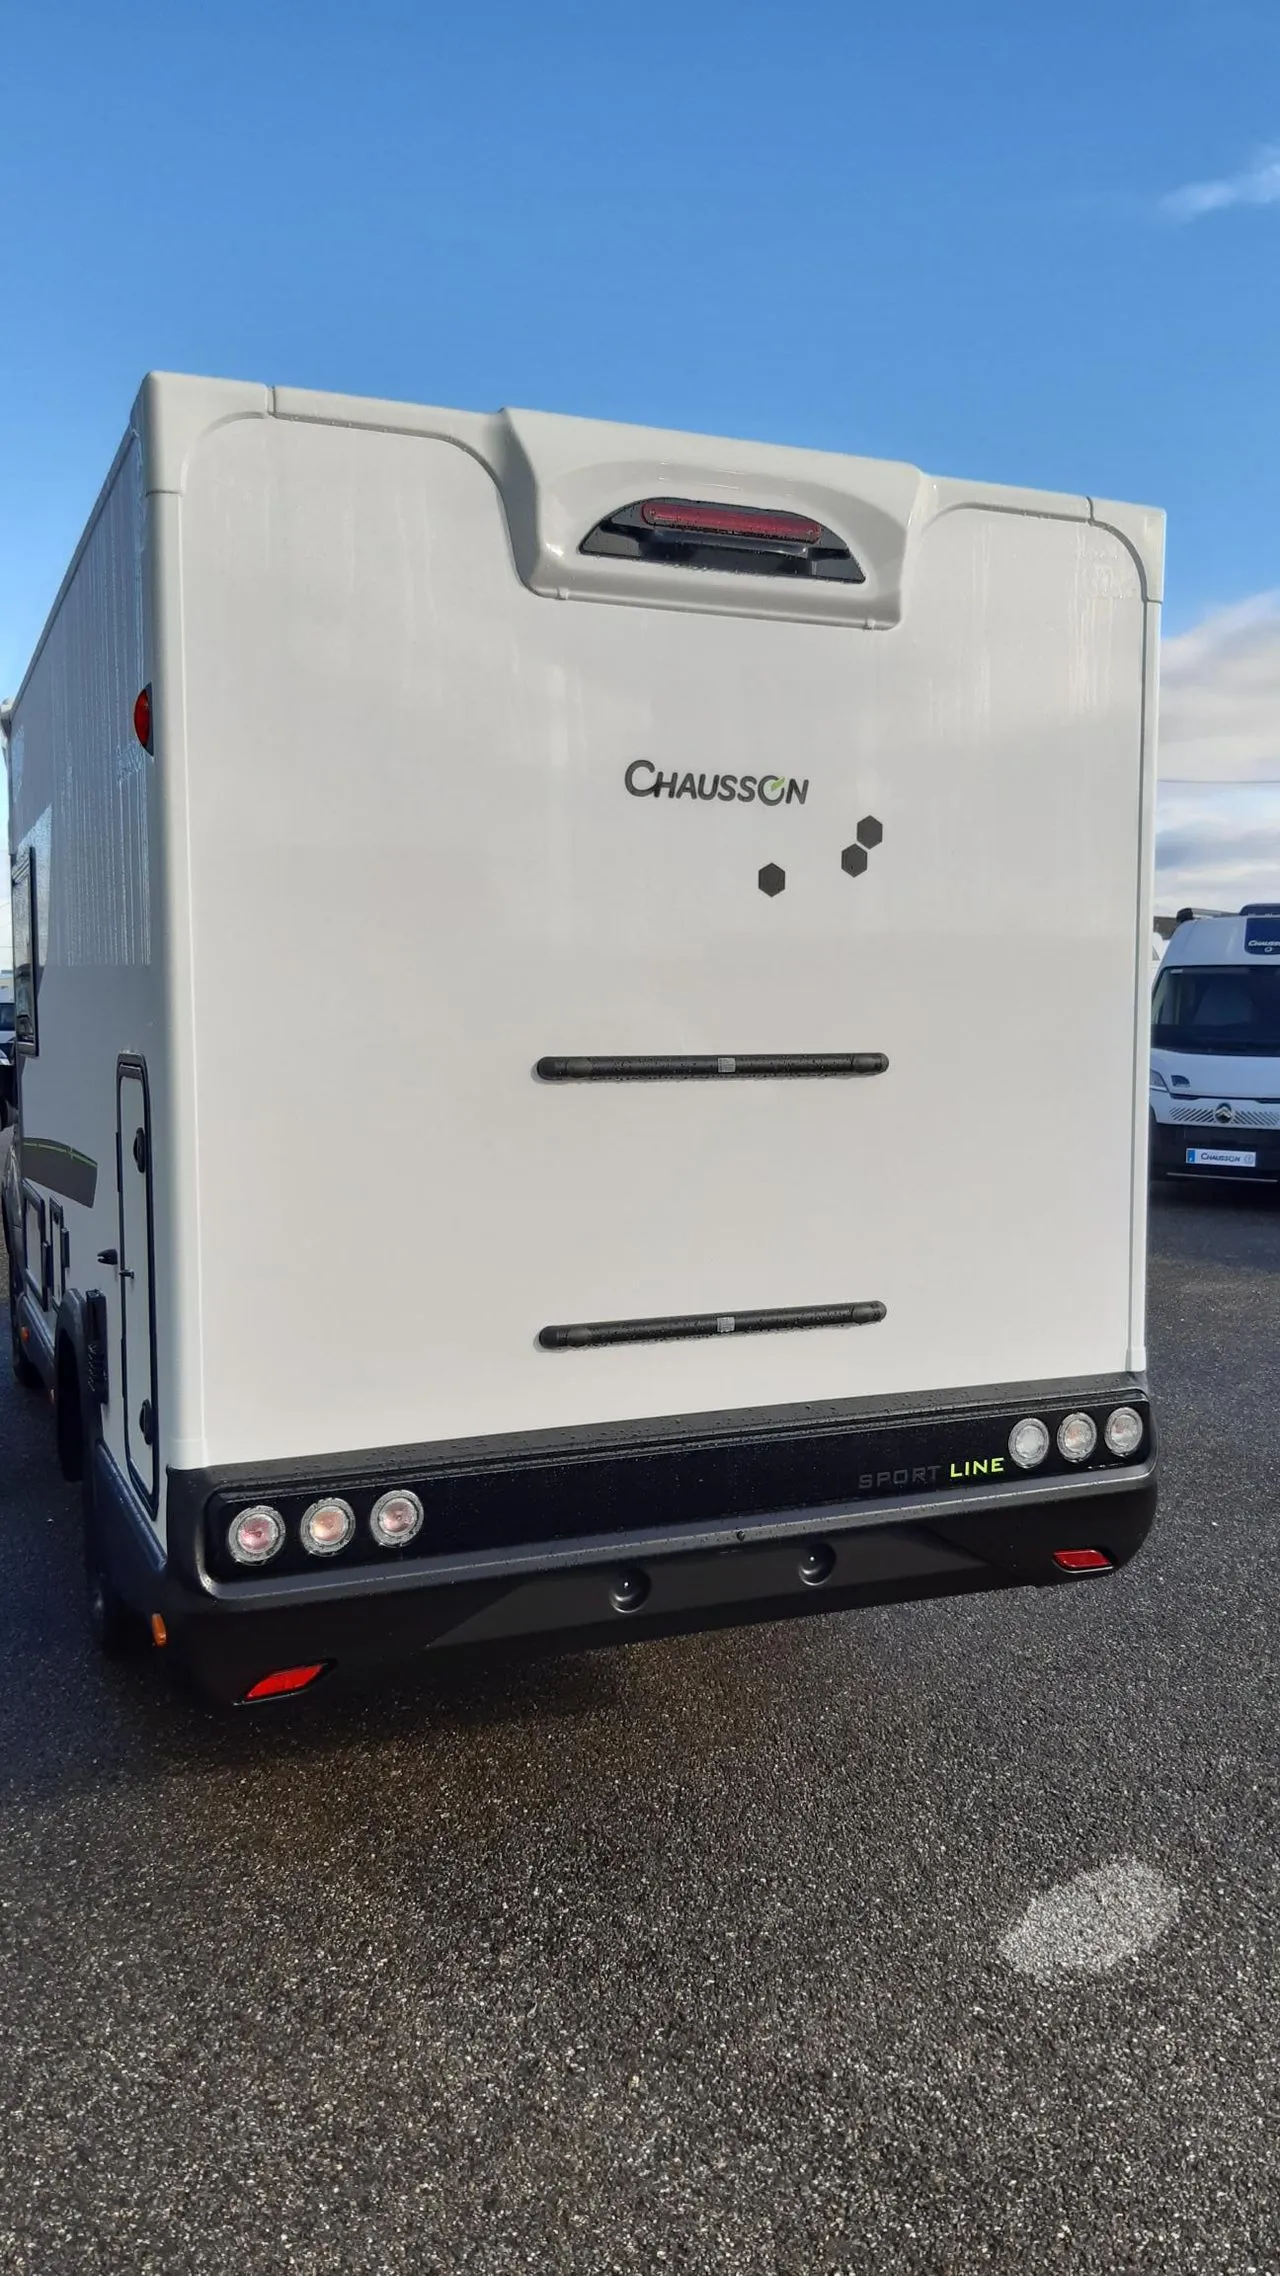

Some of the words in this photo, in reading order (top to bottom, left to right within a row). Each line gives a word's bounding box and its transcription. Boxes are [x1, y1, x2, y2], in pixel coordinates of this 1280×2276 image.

[624, 759, 809, 806] CHAUSSON
[859, 1465, 940, 1489] SPORT
[950, 1457, 1004, 1478] LINE
